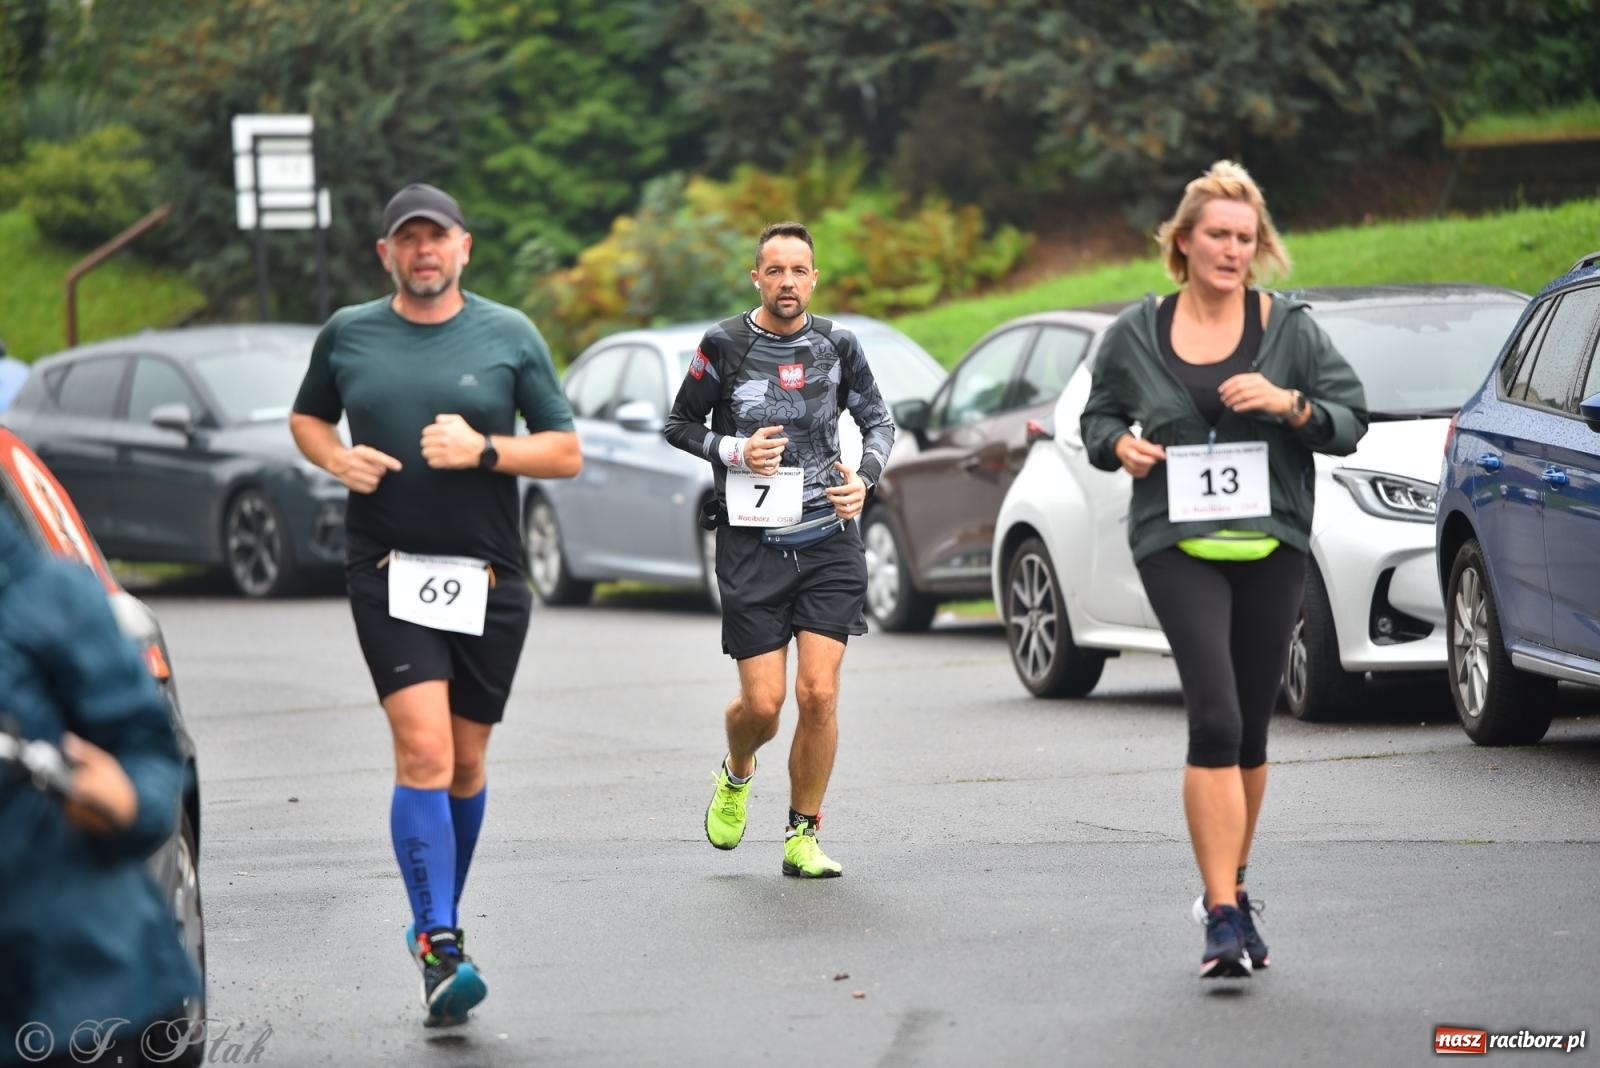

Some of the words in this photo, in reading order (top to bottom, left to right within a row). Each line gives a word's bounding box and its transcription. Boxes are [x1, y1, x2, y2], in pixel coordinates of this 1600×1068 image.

[1200, 467, 1239, 496] 13
[754, 485, 770, 508] 7
[419, 576, 461, 605] 69
